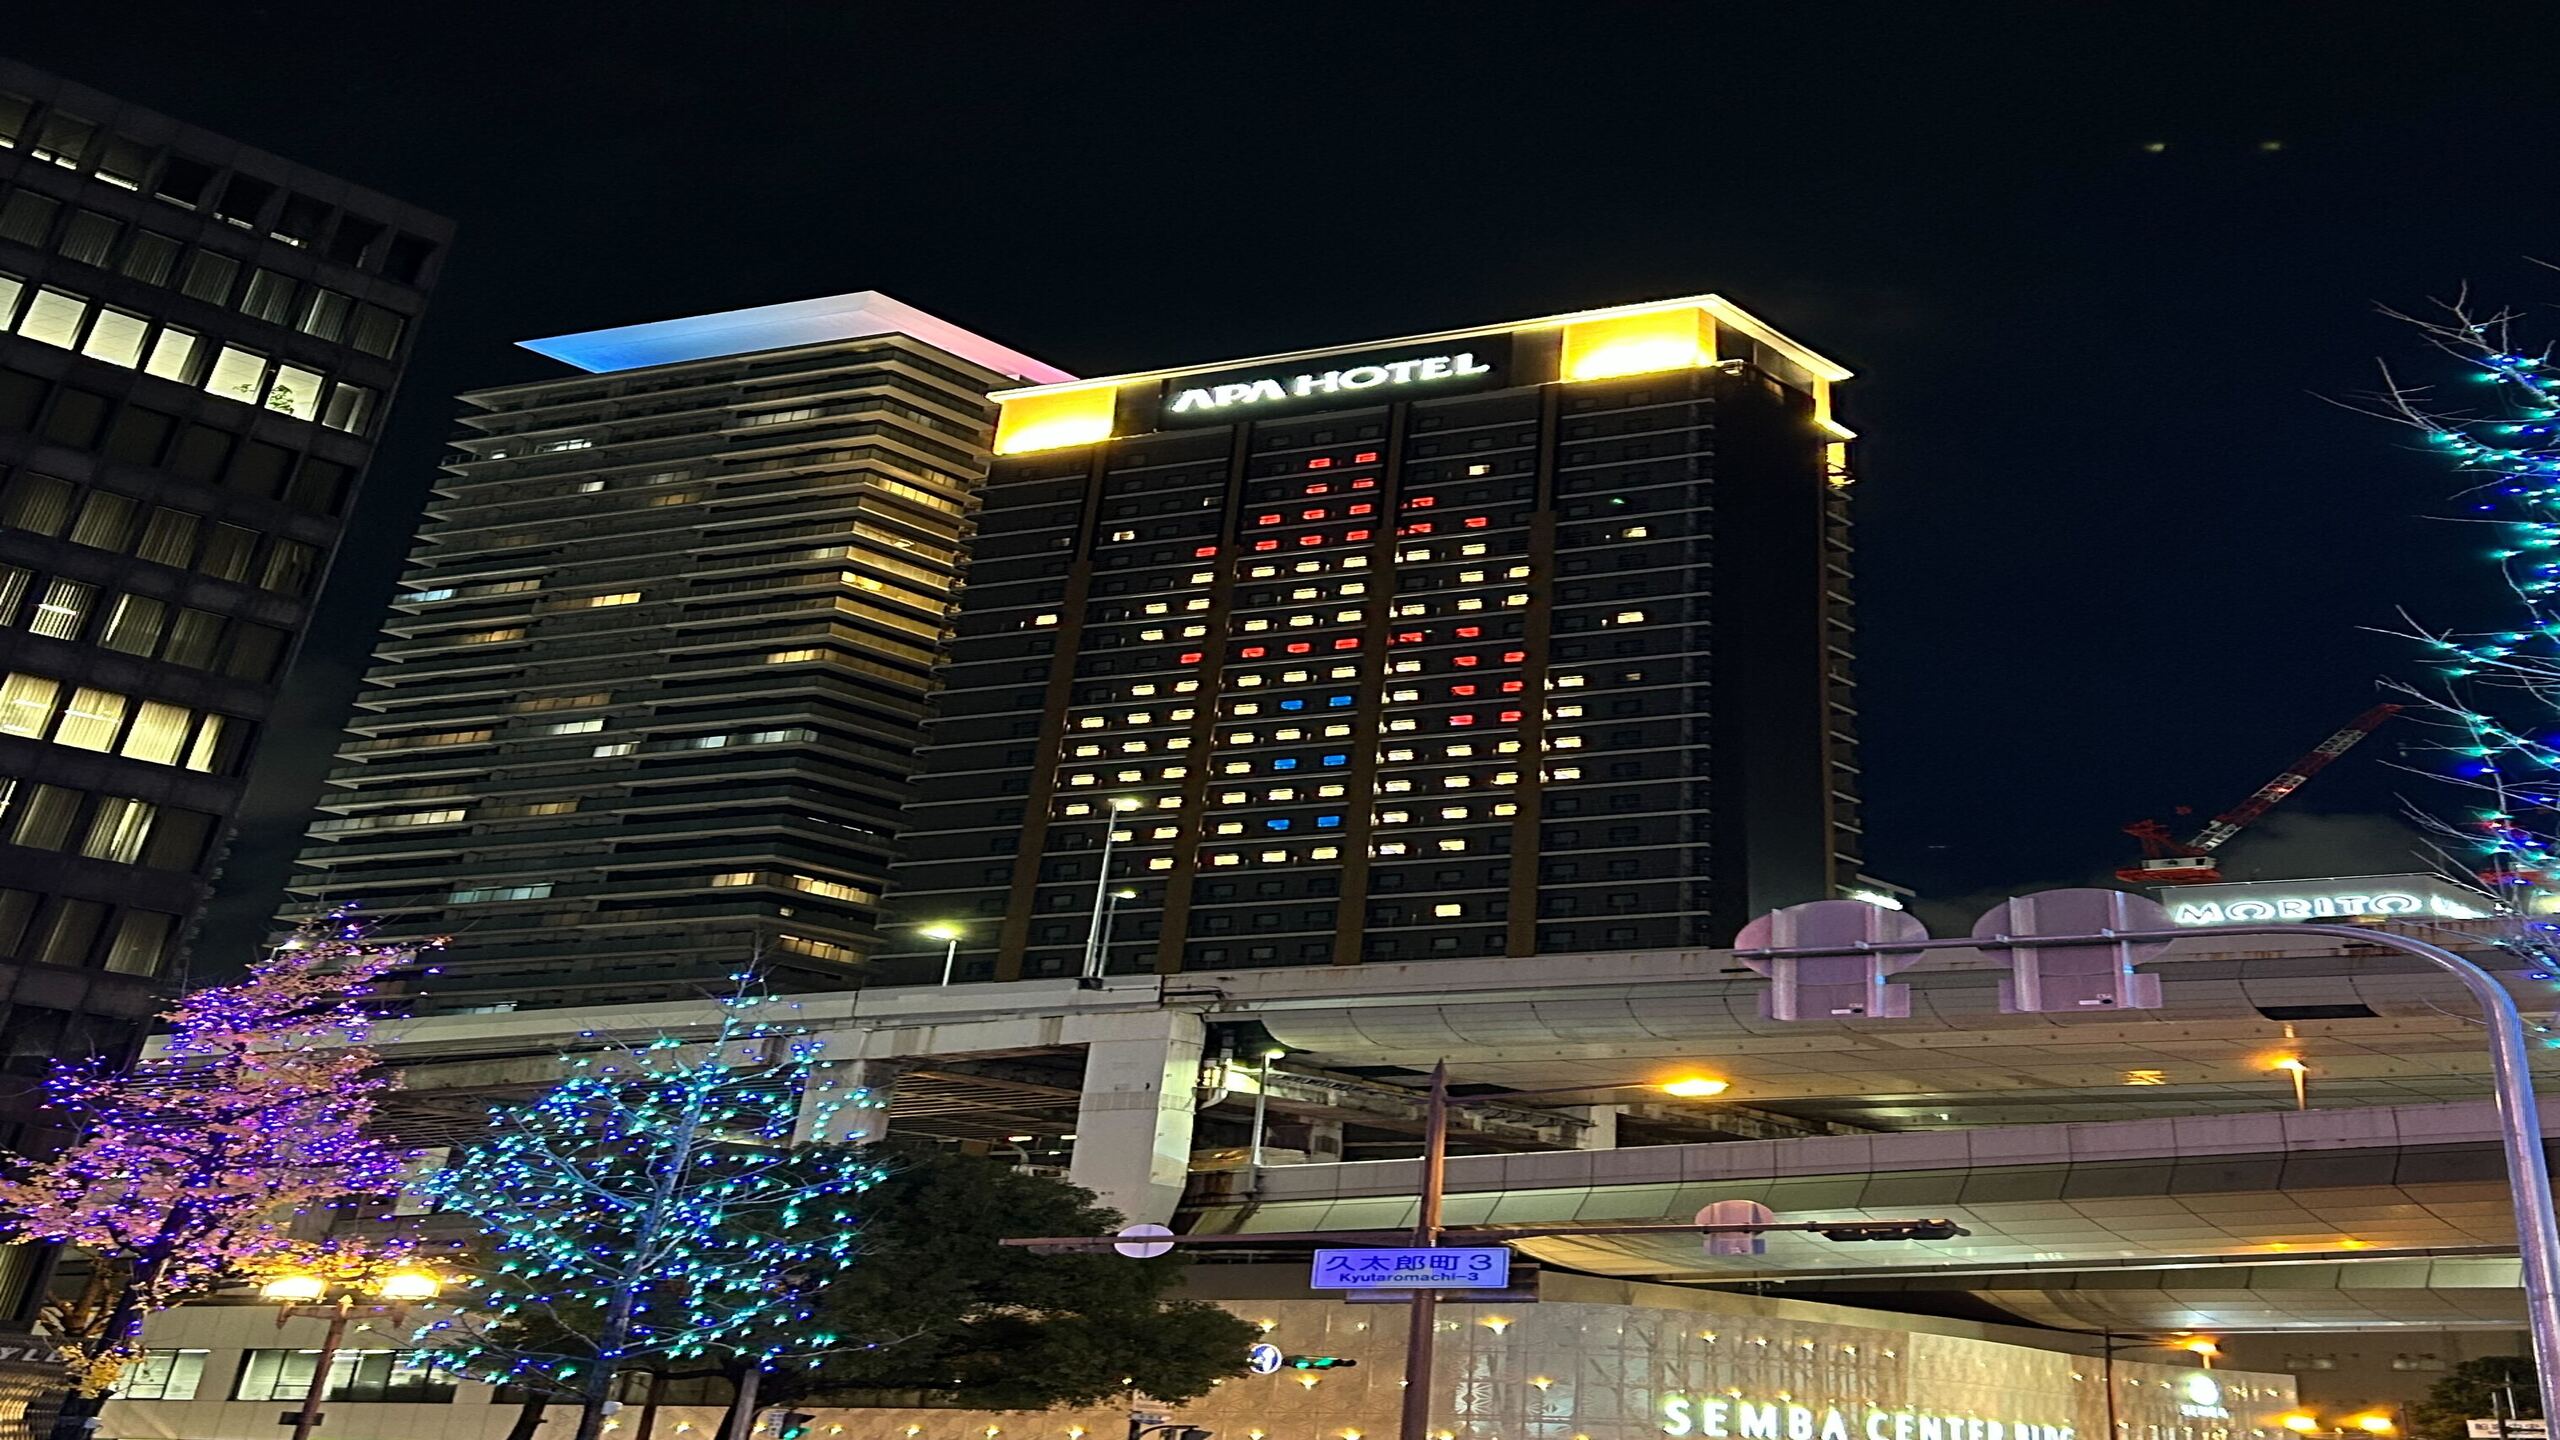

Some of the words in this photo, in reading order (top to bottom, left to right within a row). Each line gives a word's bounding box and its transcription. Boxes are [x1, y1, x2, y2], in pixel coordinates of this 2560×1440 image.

[1171, 378, 1288, 413] APA
[1294, 353, 1491, 398] HOTEL
[2174, 893, 2423, 924] MORITO
[1340, 1272, 1479, 1283] Kyutaromachi-3
[1663, 1399, 1849, 1440] SEMBA
